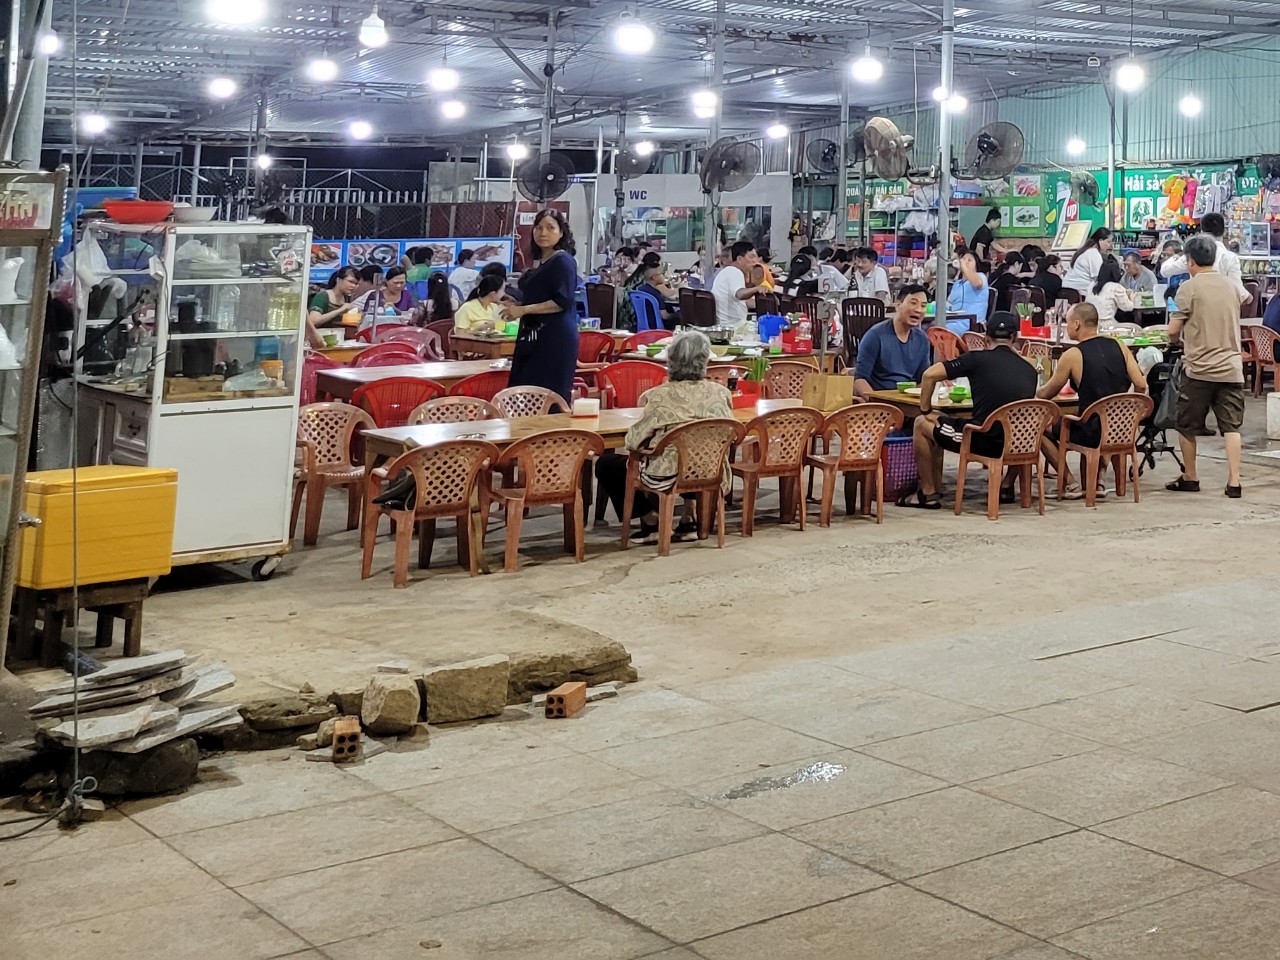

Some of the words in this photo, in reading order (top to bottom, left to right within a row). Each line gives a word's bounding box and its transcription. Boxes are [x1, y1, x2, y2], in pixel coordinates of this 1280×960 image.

[1125, 174, 1144, 191] Hải
[629, 190, 648, 200] WC
[876, 184, 887, 195] HẢI
[889, 184, 903, 195] SẢN
